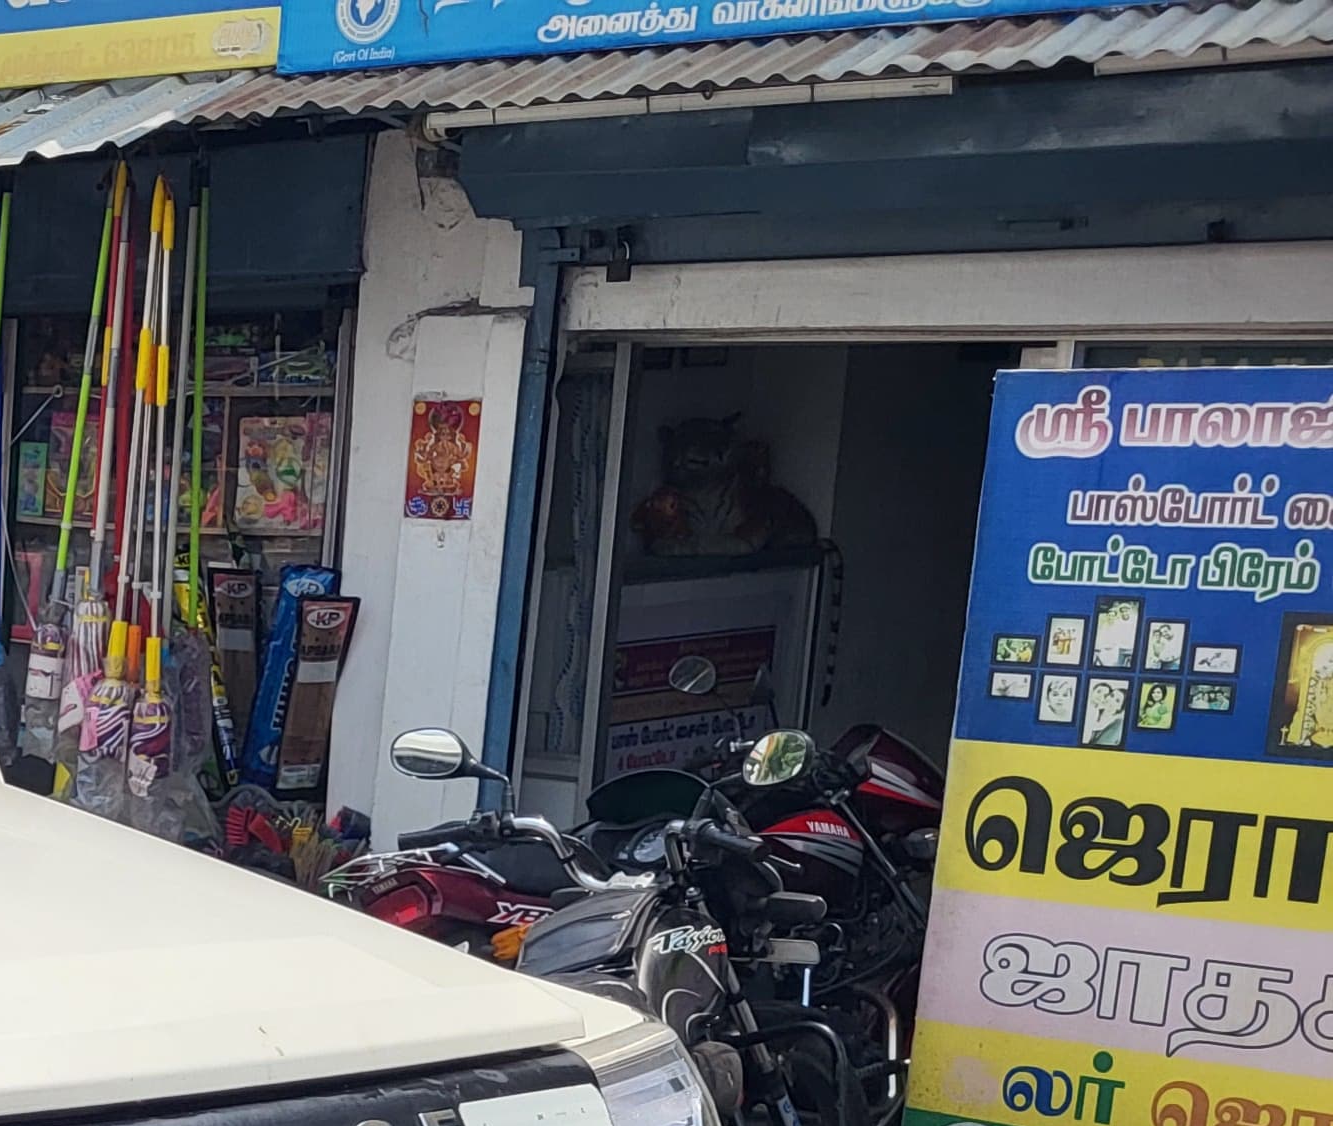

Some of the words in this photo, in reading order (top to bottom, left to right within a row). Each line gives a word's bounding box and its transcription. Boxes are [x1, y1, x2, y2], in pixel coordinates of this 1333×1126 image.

[537, 2, 697, 43] அனைத்து
[1120, 395, 1333, 449] பாலாஜ
[1066, 473, 1279, 529] பாஸ்போர்ட்
[1028, 535, 1193, 589] போட்டோ
[1197, 539, 1321, 602] பிரேம்
[314, 611, 341, 626] KP
[806, 821, 850, 838] YAMAHA
